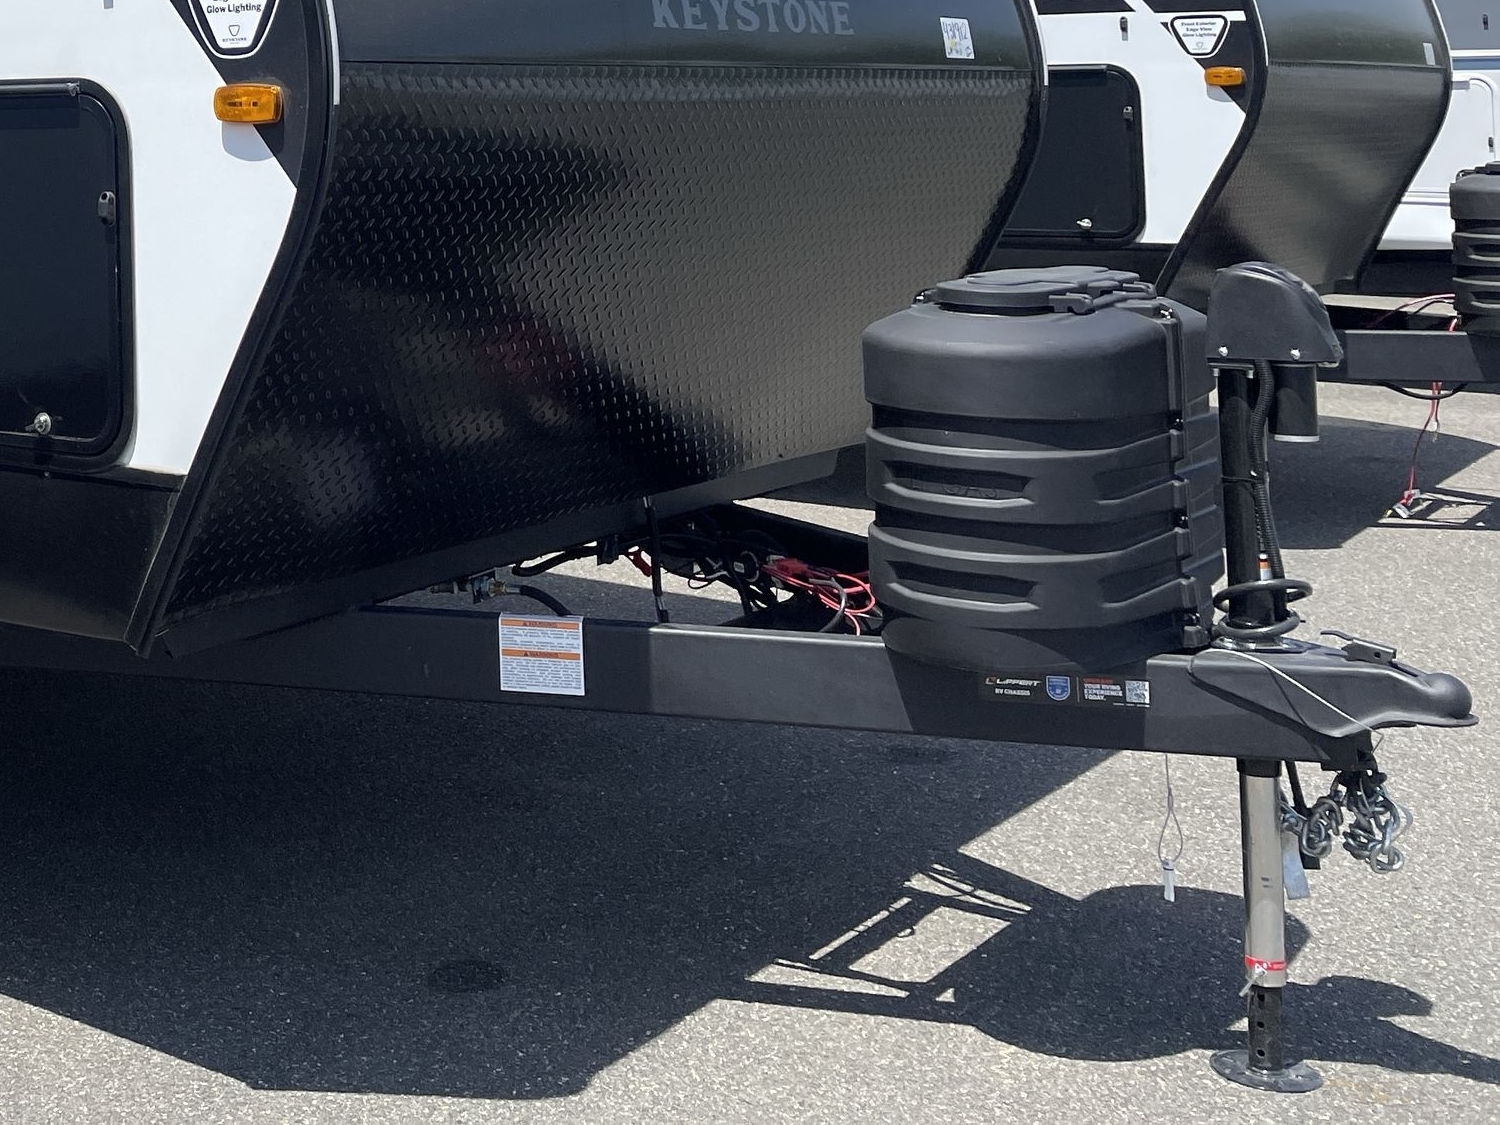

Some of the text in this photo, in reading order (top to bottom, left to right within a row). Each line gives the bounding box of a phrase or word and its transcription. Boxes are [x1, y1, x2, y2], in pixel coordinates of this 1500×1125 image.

[206, 3, 262, 13] Glow Lighting
[996, 678, 1042, 686] LIPPERT
[1084, 689, 1123, 697] EXPERIENCE
